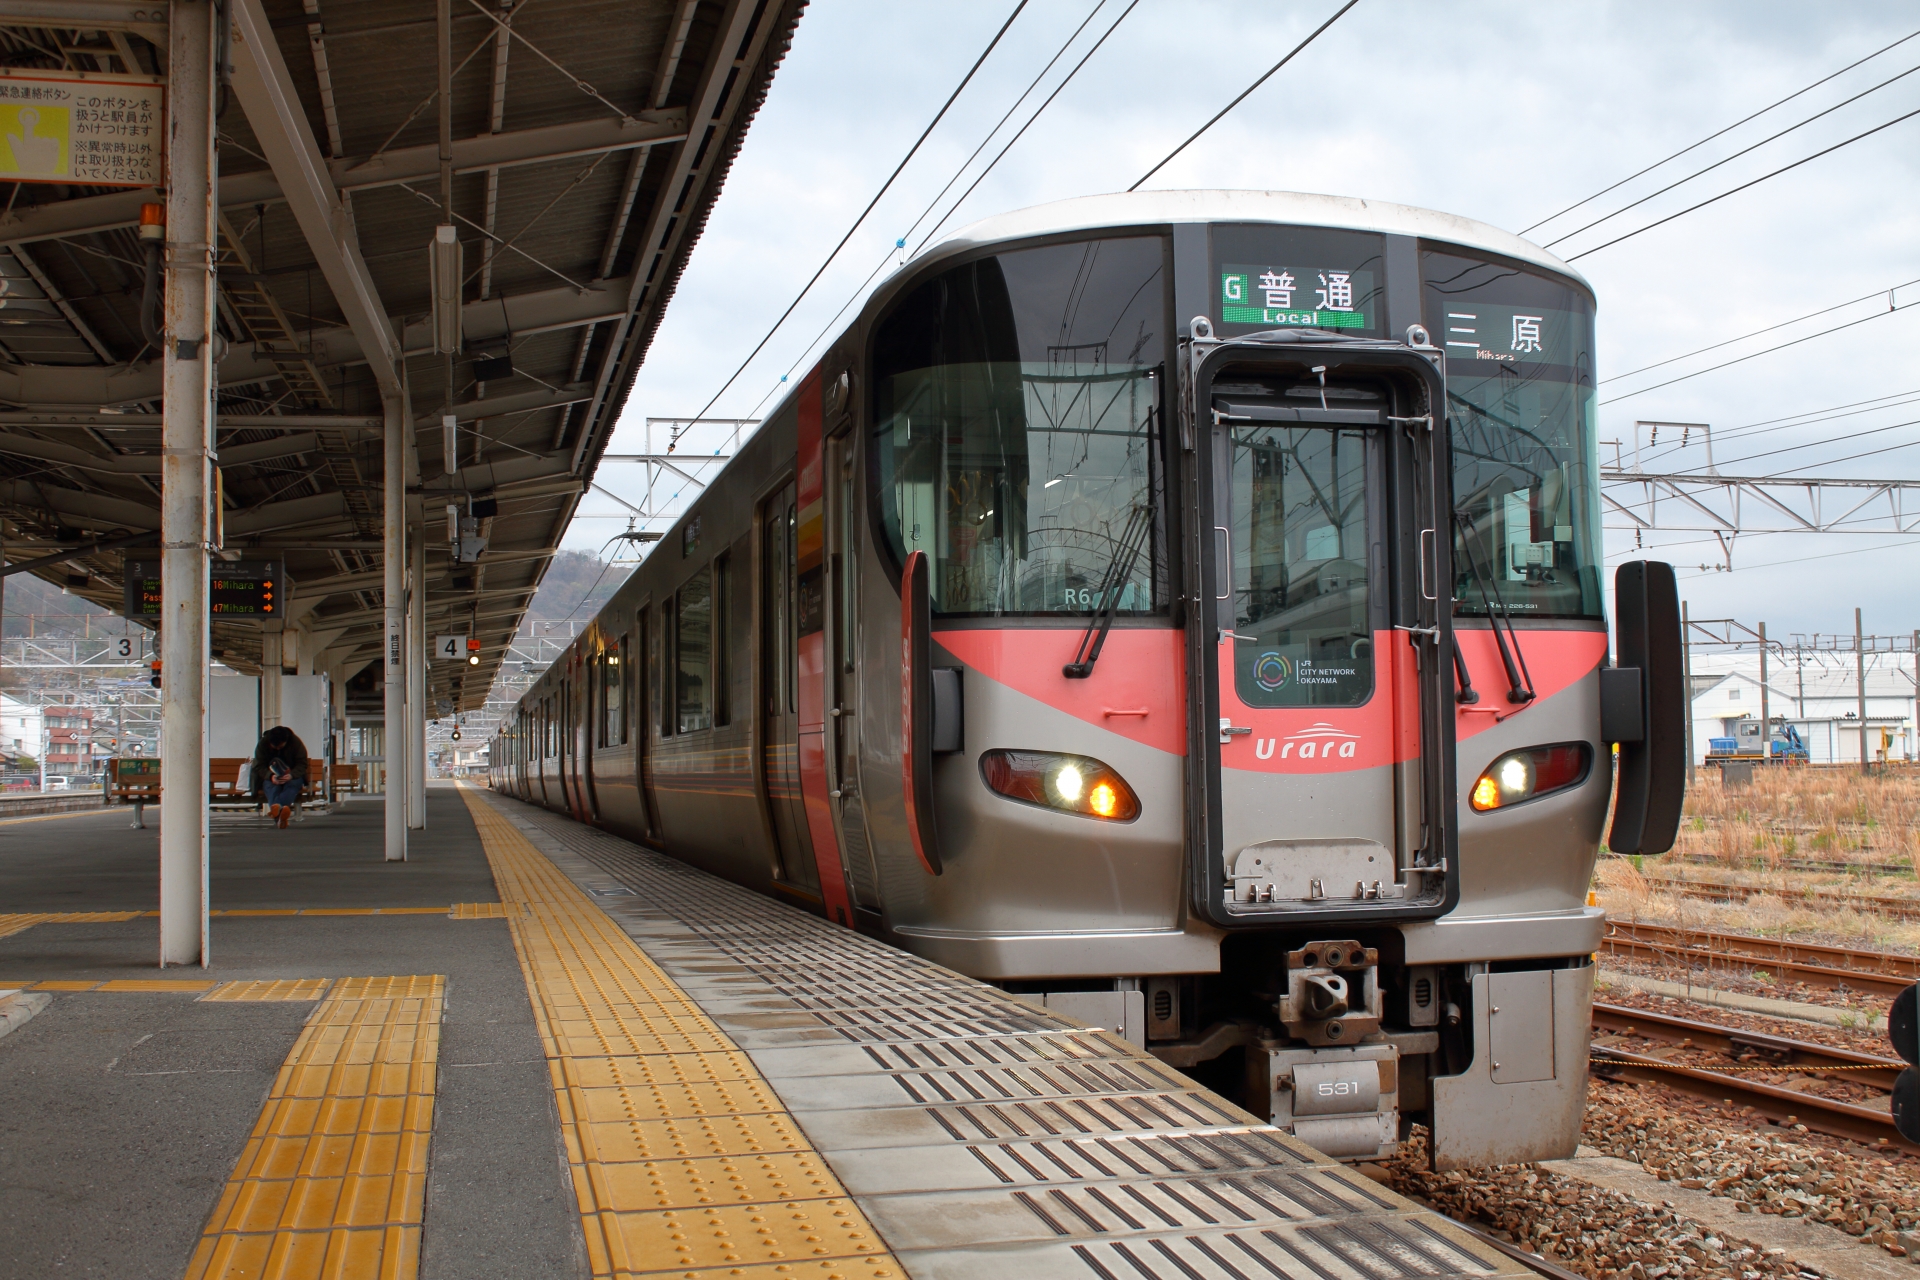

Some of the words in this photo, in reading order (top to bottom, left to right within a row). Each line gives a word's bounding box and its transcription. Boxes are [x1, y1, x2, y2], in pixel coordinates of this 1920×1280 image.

[0, 85, 71, 100] 緊急連絡ボタン
[76, 96, 152, 112] このボタンを
[76, 110, 152, 124] 扱うと駅員が
[77, 123, 153, 137] かけつけます
[75, 141, 152, 155] ※異常時以外
[75, 154, 152, 168] は取り扱わな
[75, 168, 157, 182] いでください。
[1225, 275, 1241, 300] G
[1258, 269, 1354, 312] 普通
[1263, 309, 1318, 326] Local
[1446, 312, 1544, 353] 三原
[1476, 349, 1515, 361] Mihara
[134, 562, 141, 572] 3
[265, 563, 272, 572] 4
[223, 580, 254, 590] Mihara
[1065, 588, 1090, 605] R6
[213, 603, 223, 613] 47
[223, 603, 254, 613] Mihara
[118, 638, 132, 657] 3
[390, 634, 400, 666] 終日禁煙
[444, 639, 457, 657] 4
[1300, 668, 1317, 676] CITY
[1318, 668, 1356, 676] NETWORK
[460, 716, 466, 725] 4
[1255, 738, 1356, 760] Urara
[1318, 1081, 1358, 1096] 531
